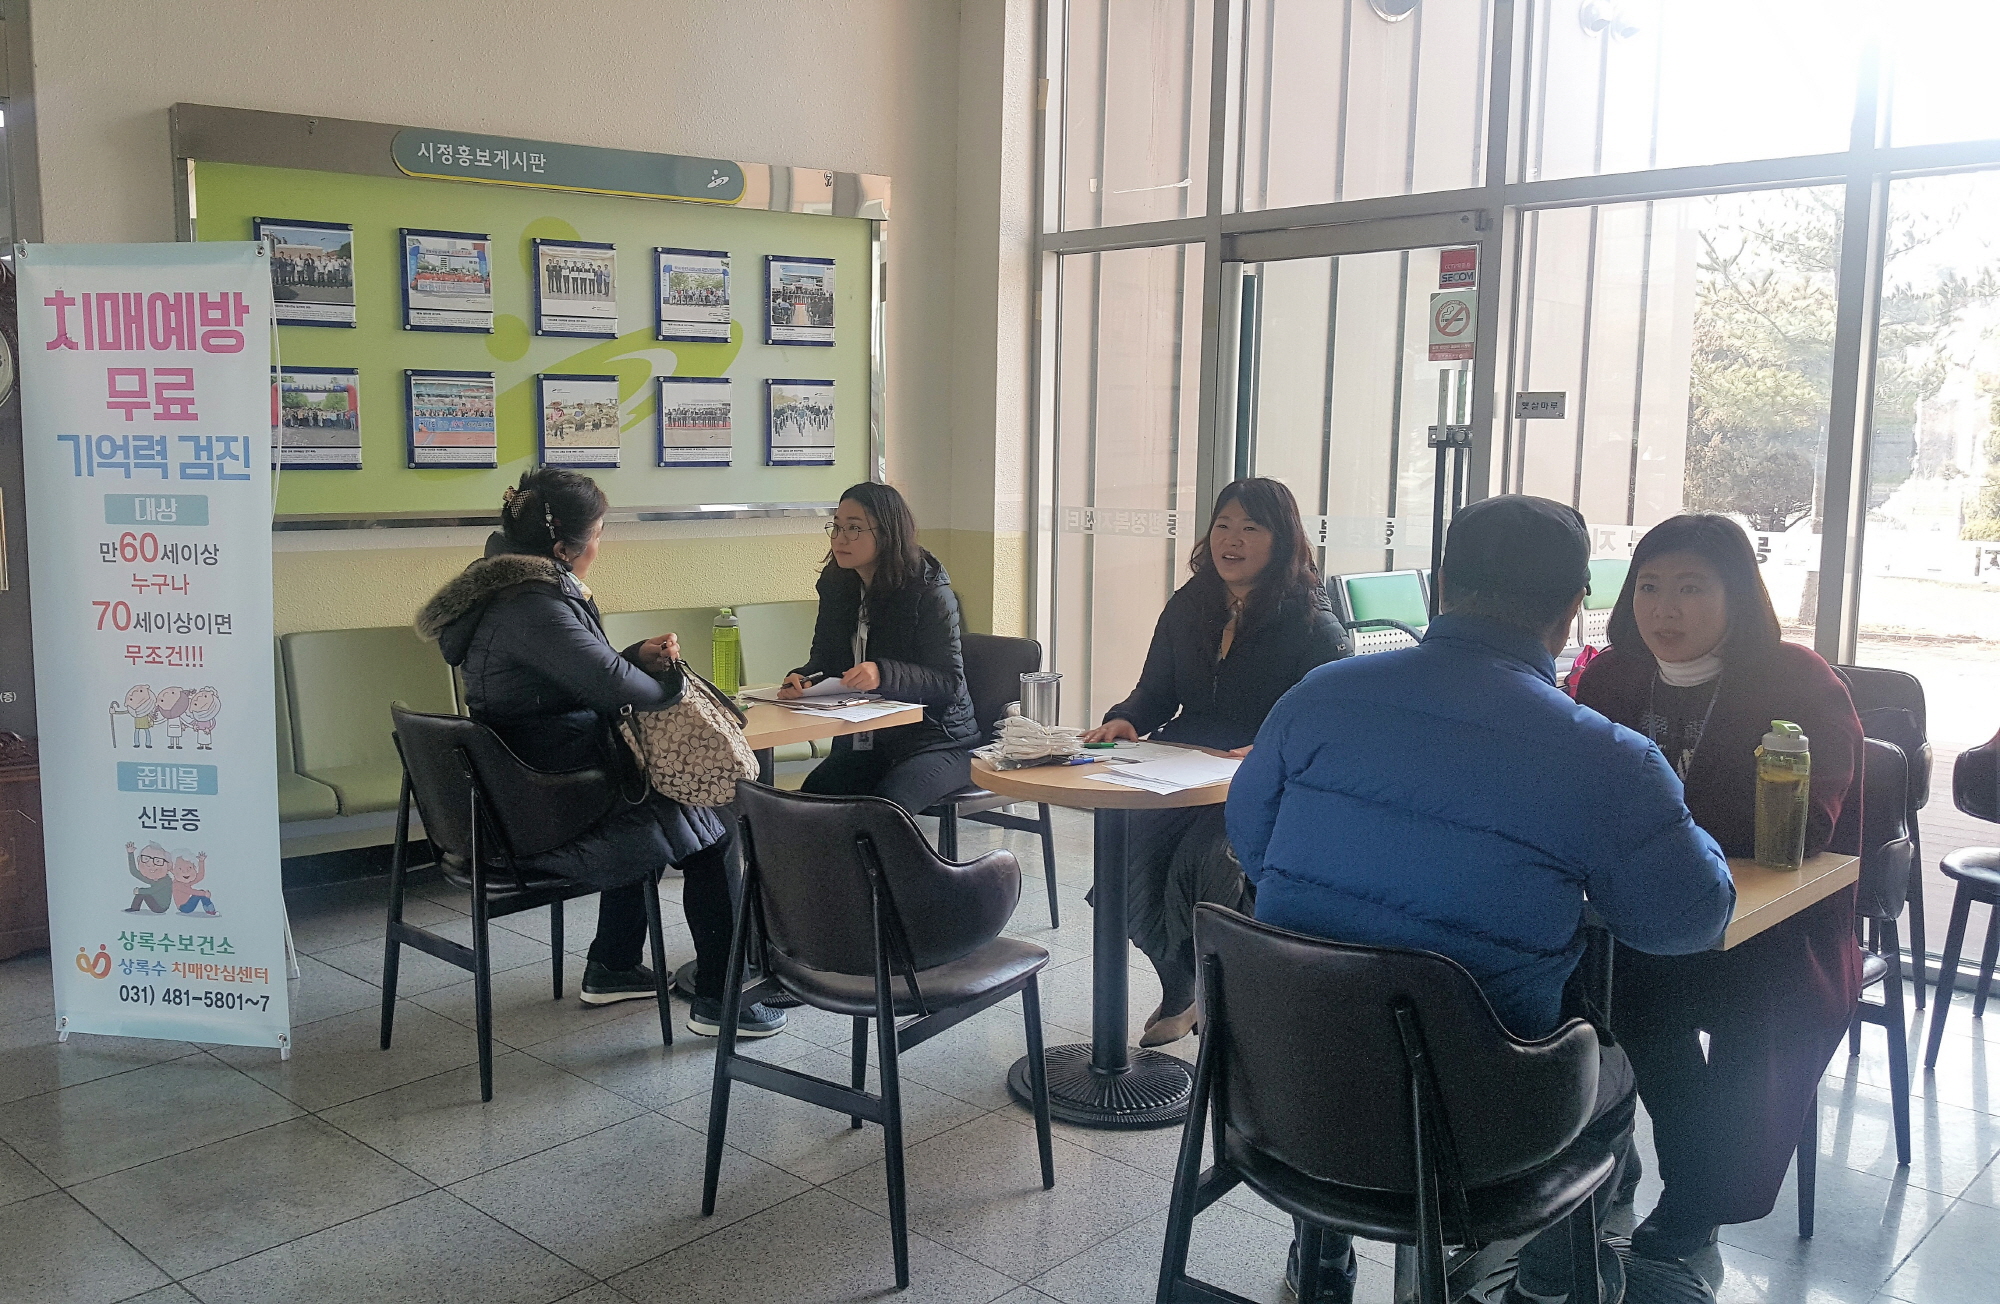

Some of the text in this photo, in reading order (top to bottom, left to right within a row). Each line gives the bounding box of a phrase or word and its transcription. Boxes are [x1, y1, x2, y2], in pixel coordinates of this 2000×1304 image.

[417, 141, 547, 174] 시정홍보게시판
[1441, 271, 1474, 283] SECOM
[43, 289, 250, 354] 치매예방
[106, 367, 199, 422] 무료
[56, 434, 251, 481] 기억력 검진
[134, 497, 178, 523] 대상
[99, 531, 219, 566] 만60세이상
[131, 573, 190, 595] 누구나
[92, 600, 233, 636] 70세이상이면
[124, 644, 204, 669] 무조건!!!
[136, 766, 199, 792] 준비물
[138, 806, 201, 832] 신분증
[117, 930, 236, 956] 상록수보건소
[117, 957, 269, 985] 상록수 치매안심센터
[119, 984, 270, 1013] 031) 481-5801~7
